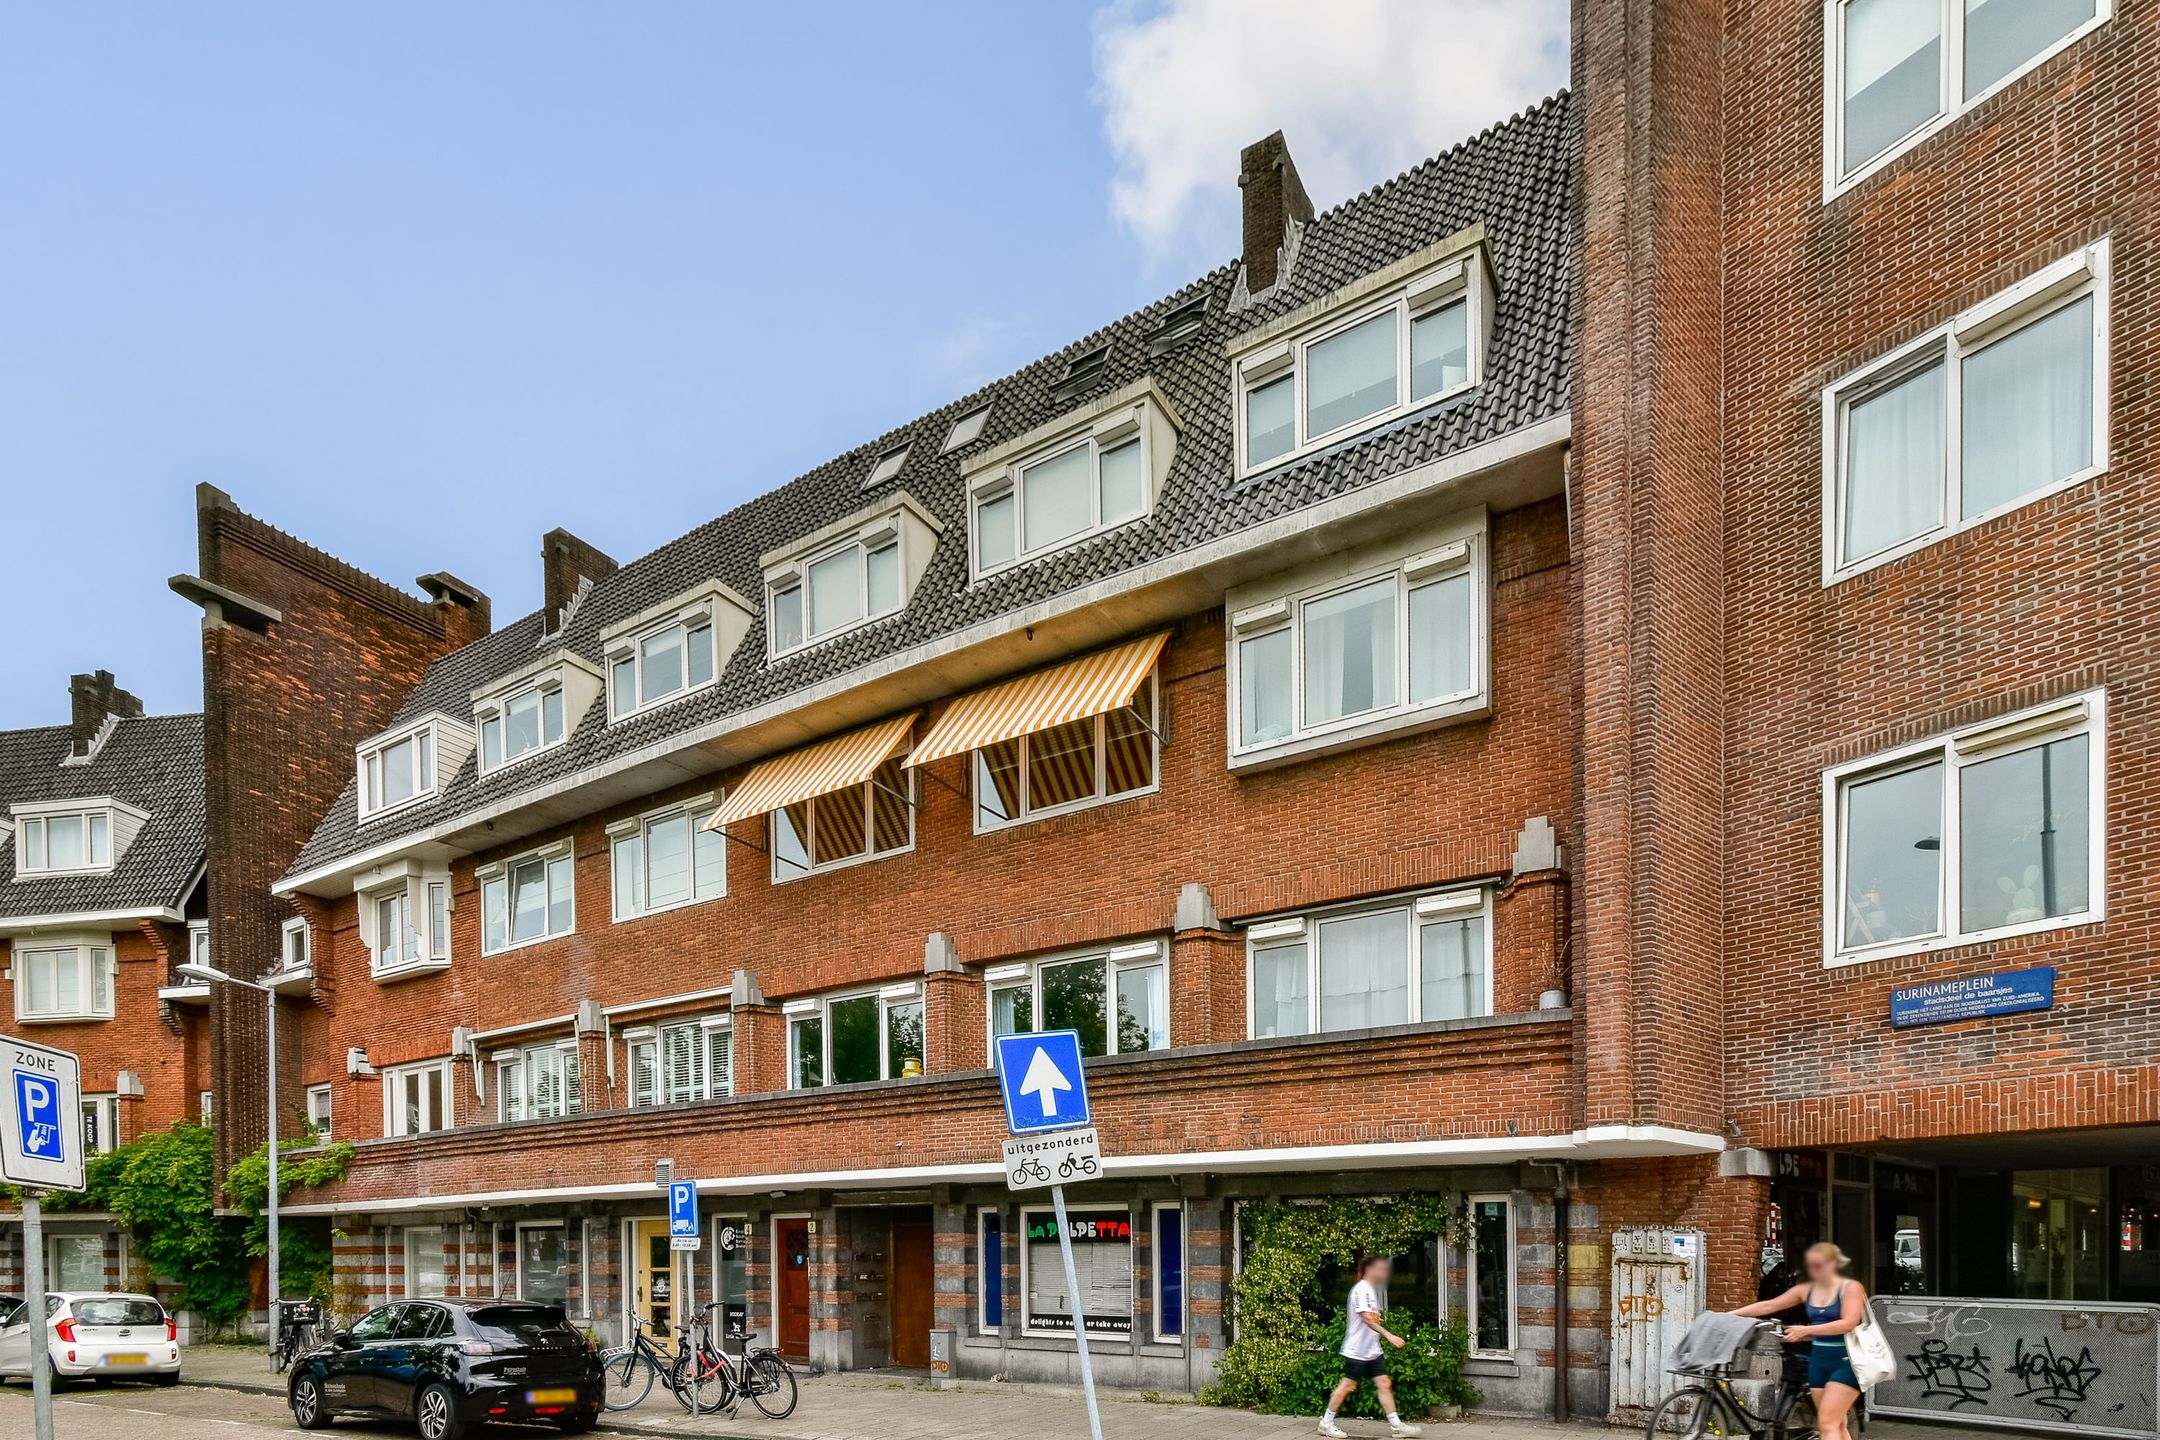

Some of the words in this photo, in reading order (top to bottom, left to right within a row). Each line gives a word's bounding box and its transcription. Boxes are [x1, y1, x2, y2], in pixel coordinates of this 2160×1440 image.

[1896, 977, 1993, 1001] SURINAMEPLEIN
[1924, 994, 1962, 1005] stadsdeel
[1978, 987, 2013, 997] baarsjes
[16, 1051, 56, 1072] ZONE
[24, 1080, 50, 1122] P
[1008, 1134, 1093, 1155] uitgezonderd
[675, 1186, 689, 1213] P
[1028, 1222, 1045, 1237] LA
[1047, 1222, 1131, 1238] PLPETTA
[1030, 1318, 1054, 1327] delights
[1066, 1319, 1075, 1327] ea
[1096, 1320, 1111, 1328] take
